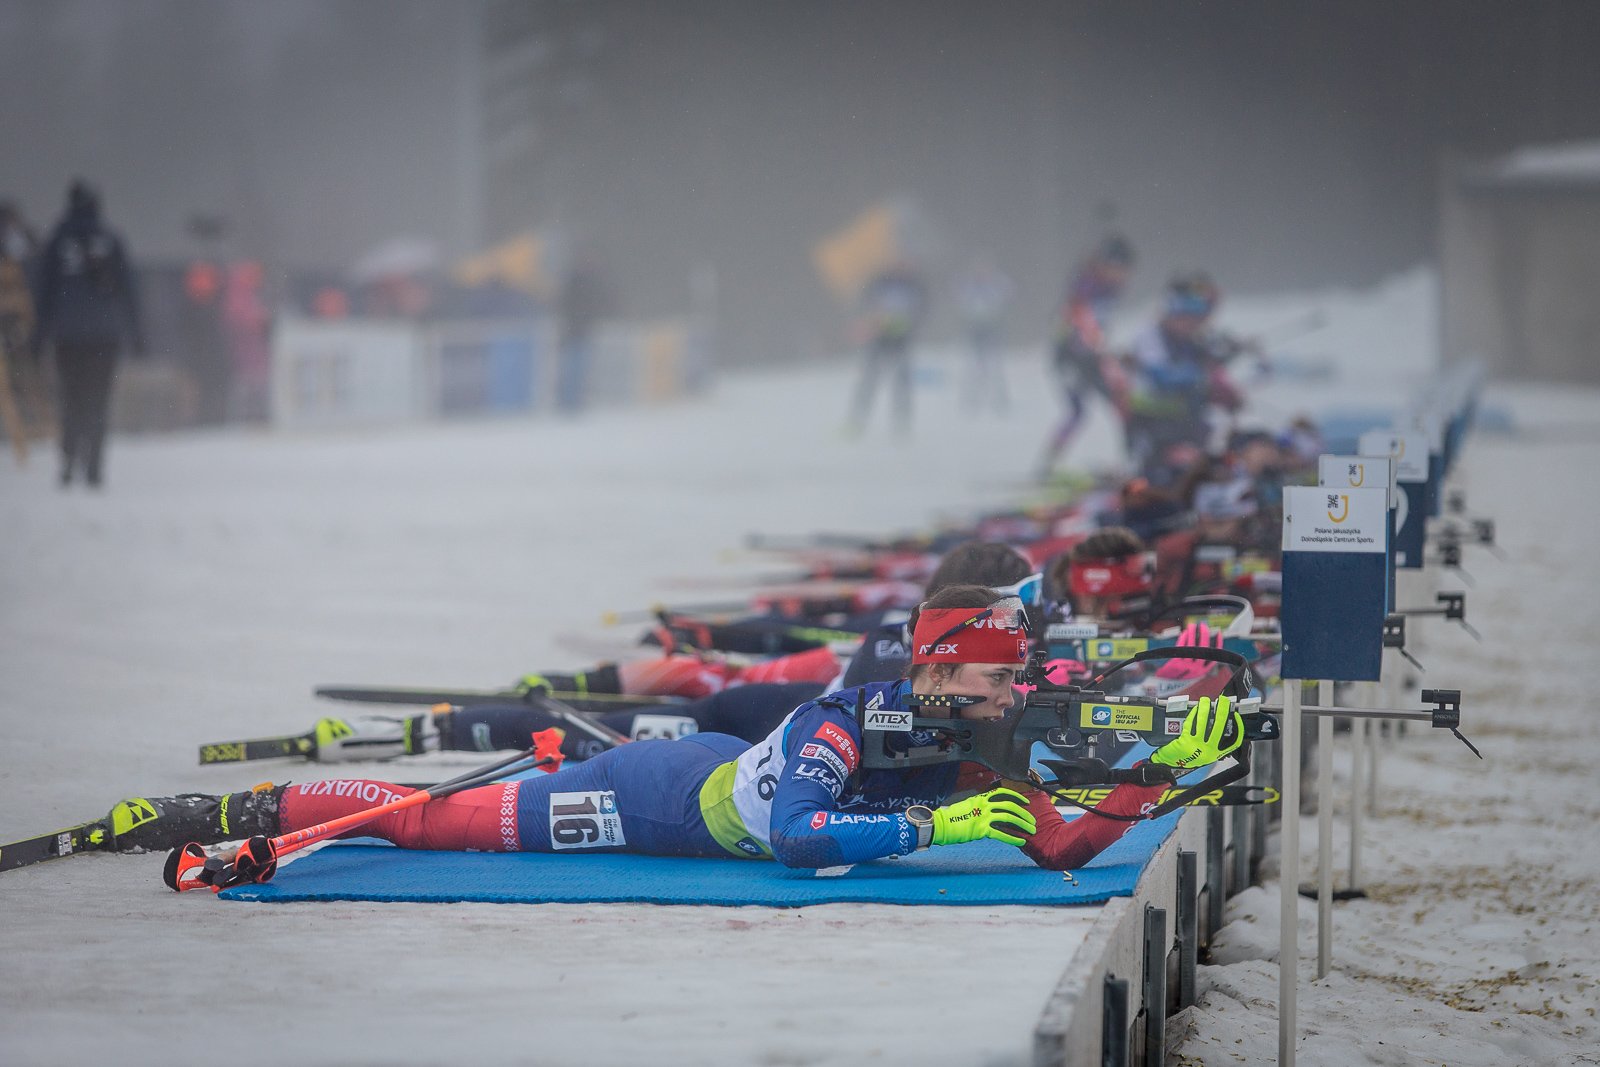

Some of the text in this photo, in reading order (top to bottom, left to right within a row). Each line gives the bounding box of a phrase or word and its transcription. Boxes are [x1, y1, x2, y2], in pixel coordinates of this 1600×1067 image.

[867, 713, 910, 725] ATEX
[552, 796, 600, 844] 16
[830, 814, 891, 825] LAPUA
